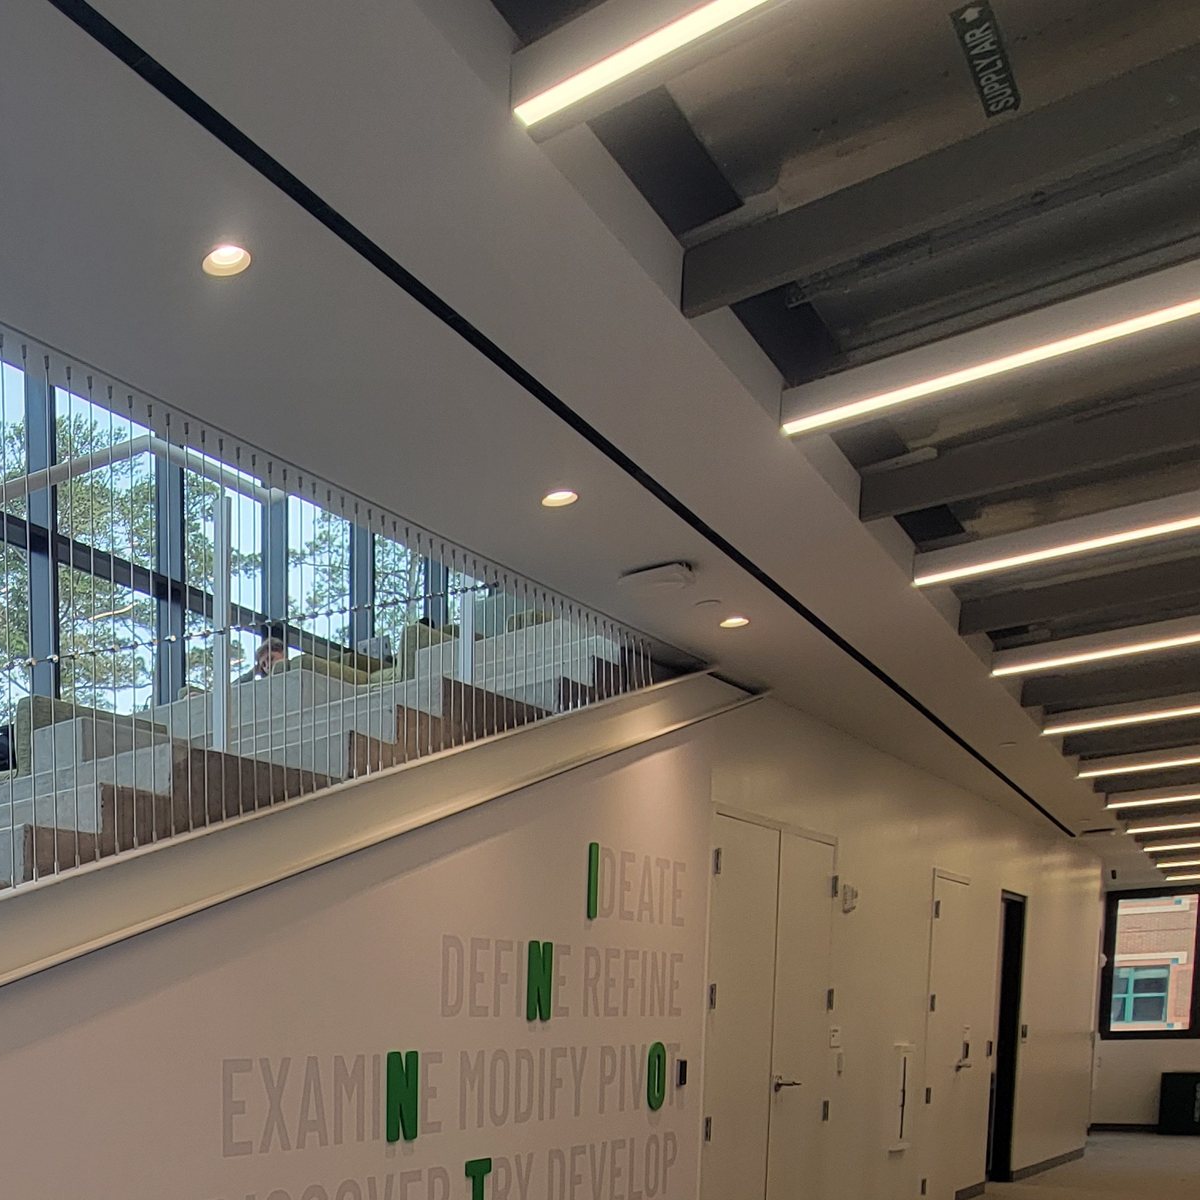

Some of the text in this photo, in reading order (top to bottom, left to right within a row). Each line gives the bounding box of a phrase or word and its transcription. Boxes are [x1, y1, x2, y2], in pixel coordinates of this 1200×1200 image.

[965, 23, 1015, 112] SUPPLY AIR
[587, 842, 686, 927] IDEATE
[440, 934, 684, 1022] DEFINE REFINE
[222, 1041, 681, 1158] EXAMINE MODIFY PIVOT
